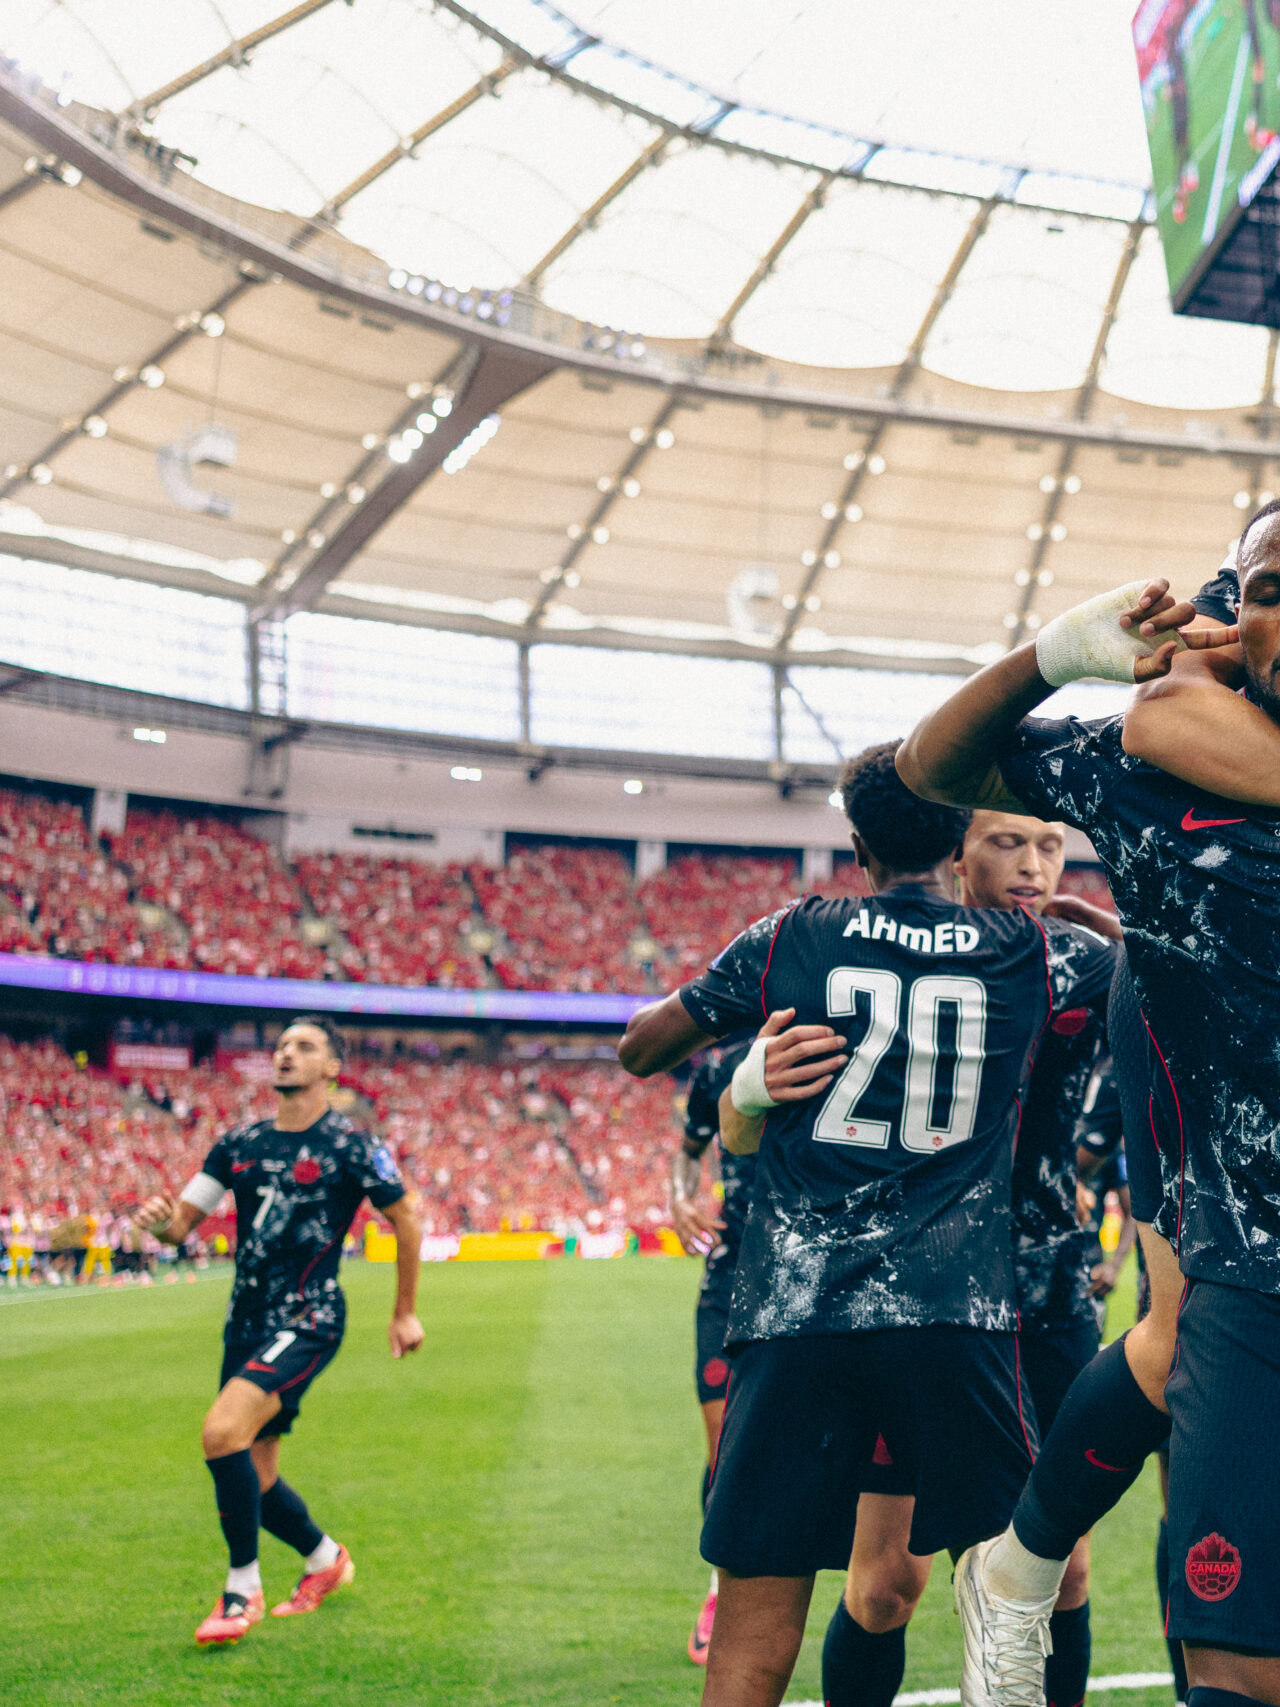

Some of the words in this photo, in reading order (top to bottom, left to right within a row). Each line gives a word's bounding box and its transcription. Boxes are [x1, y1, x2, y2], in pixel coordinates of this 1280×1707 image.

[812, 966, 987, 1153] 20
[252, 1185, 275, 1229] 7
[1188, 1562, 1237, 1574] CANADA
